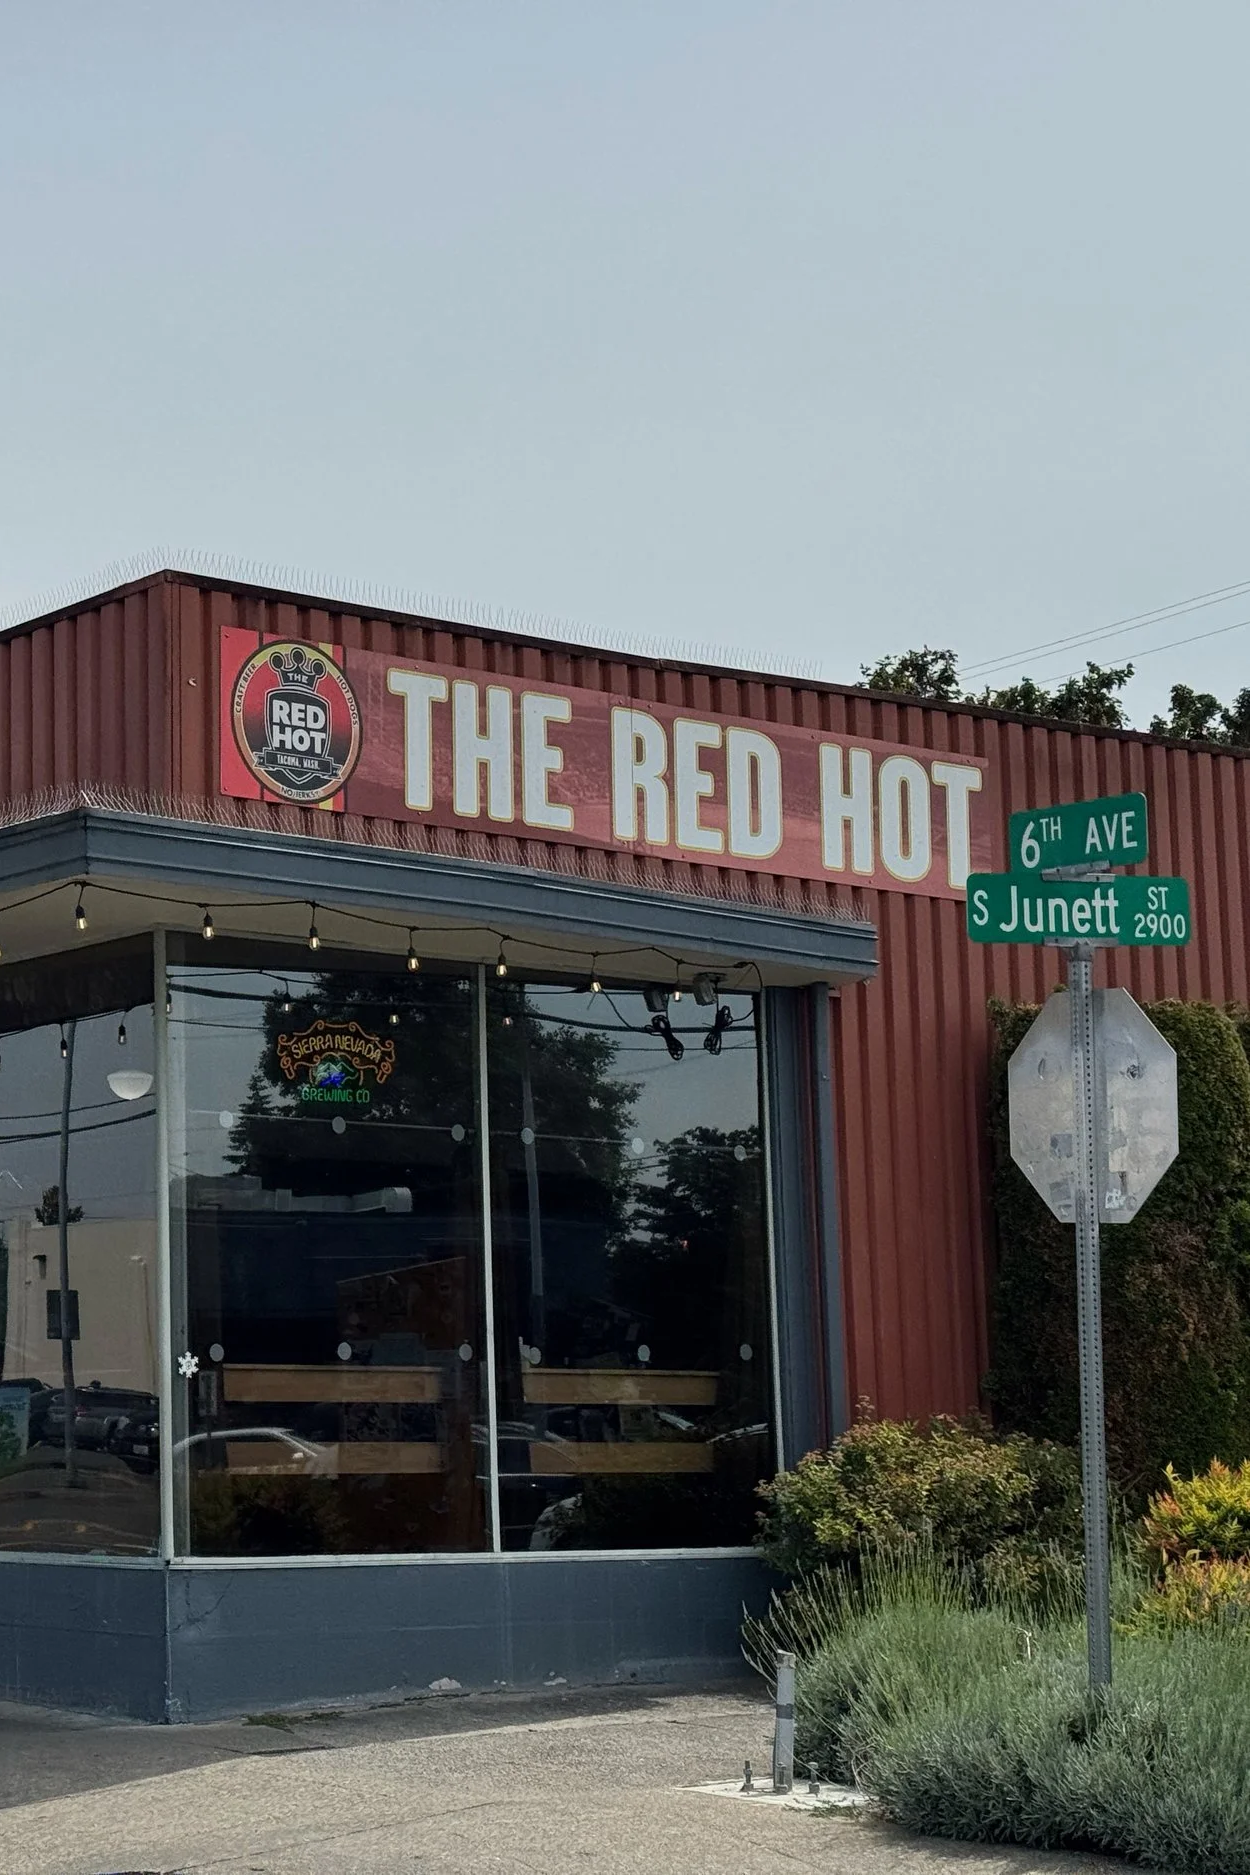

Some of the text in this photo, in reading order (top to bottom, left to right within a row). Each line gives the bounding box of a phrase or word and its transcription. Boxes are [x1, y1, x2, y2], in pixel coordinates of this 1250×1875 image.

[287, 672, 309, 684] THE
[336, 675, 350, 695] HOT
[235, 683, 246, 713] CRAFT
[271, 699, 326, 731] RED
[271, 725, 327, 755] HOT
[386, 667, 983, 891] THE RED HOT
[1021, 811, 1138, 869] 6TH AVE
[973, 886, 1168, 934] S Junett ST
[1134, 913, 1186, 939] 2900
[291, 1034, 382, 1063] SIERRA NEVADA
